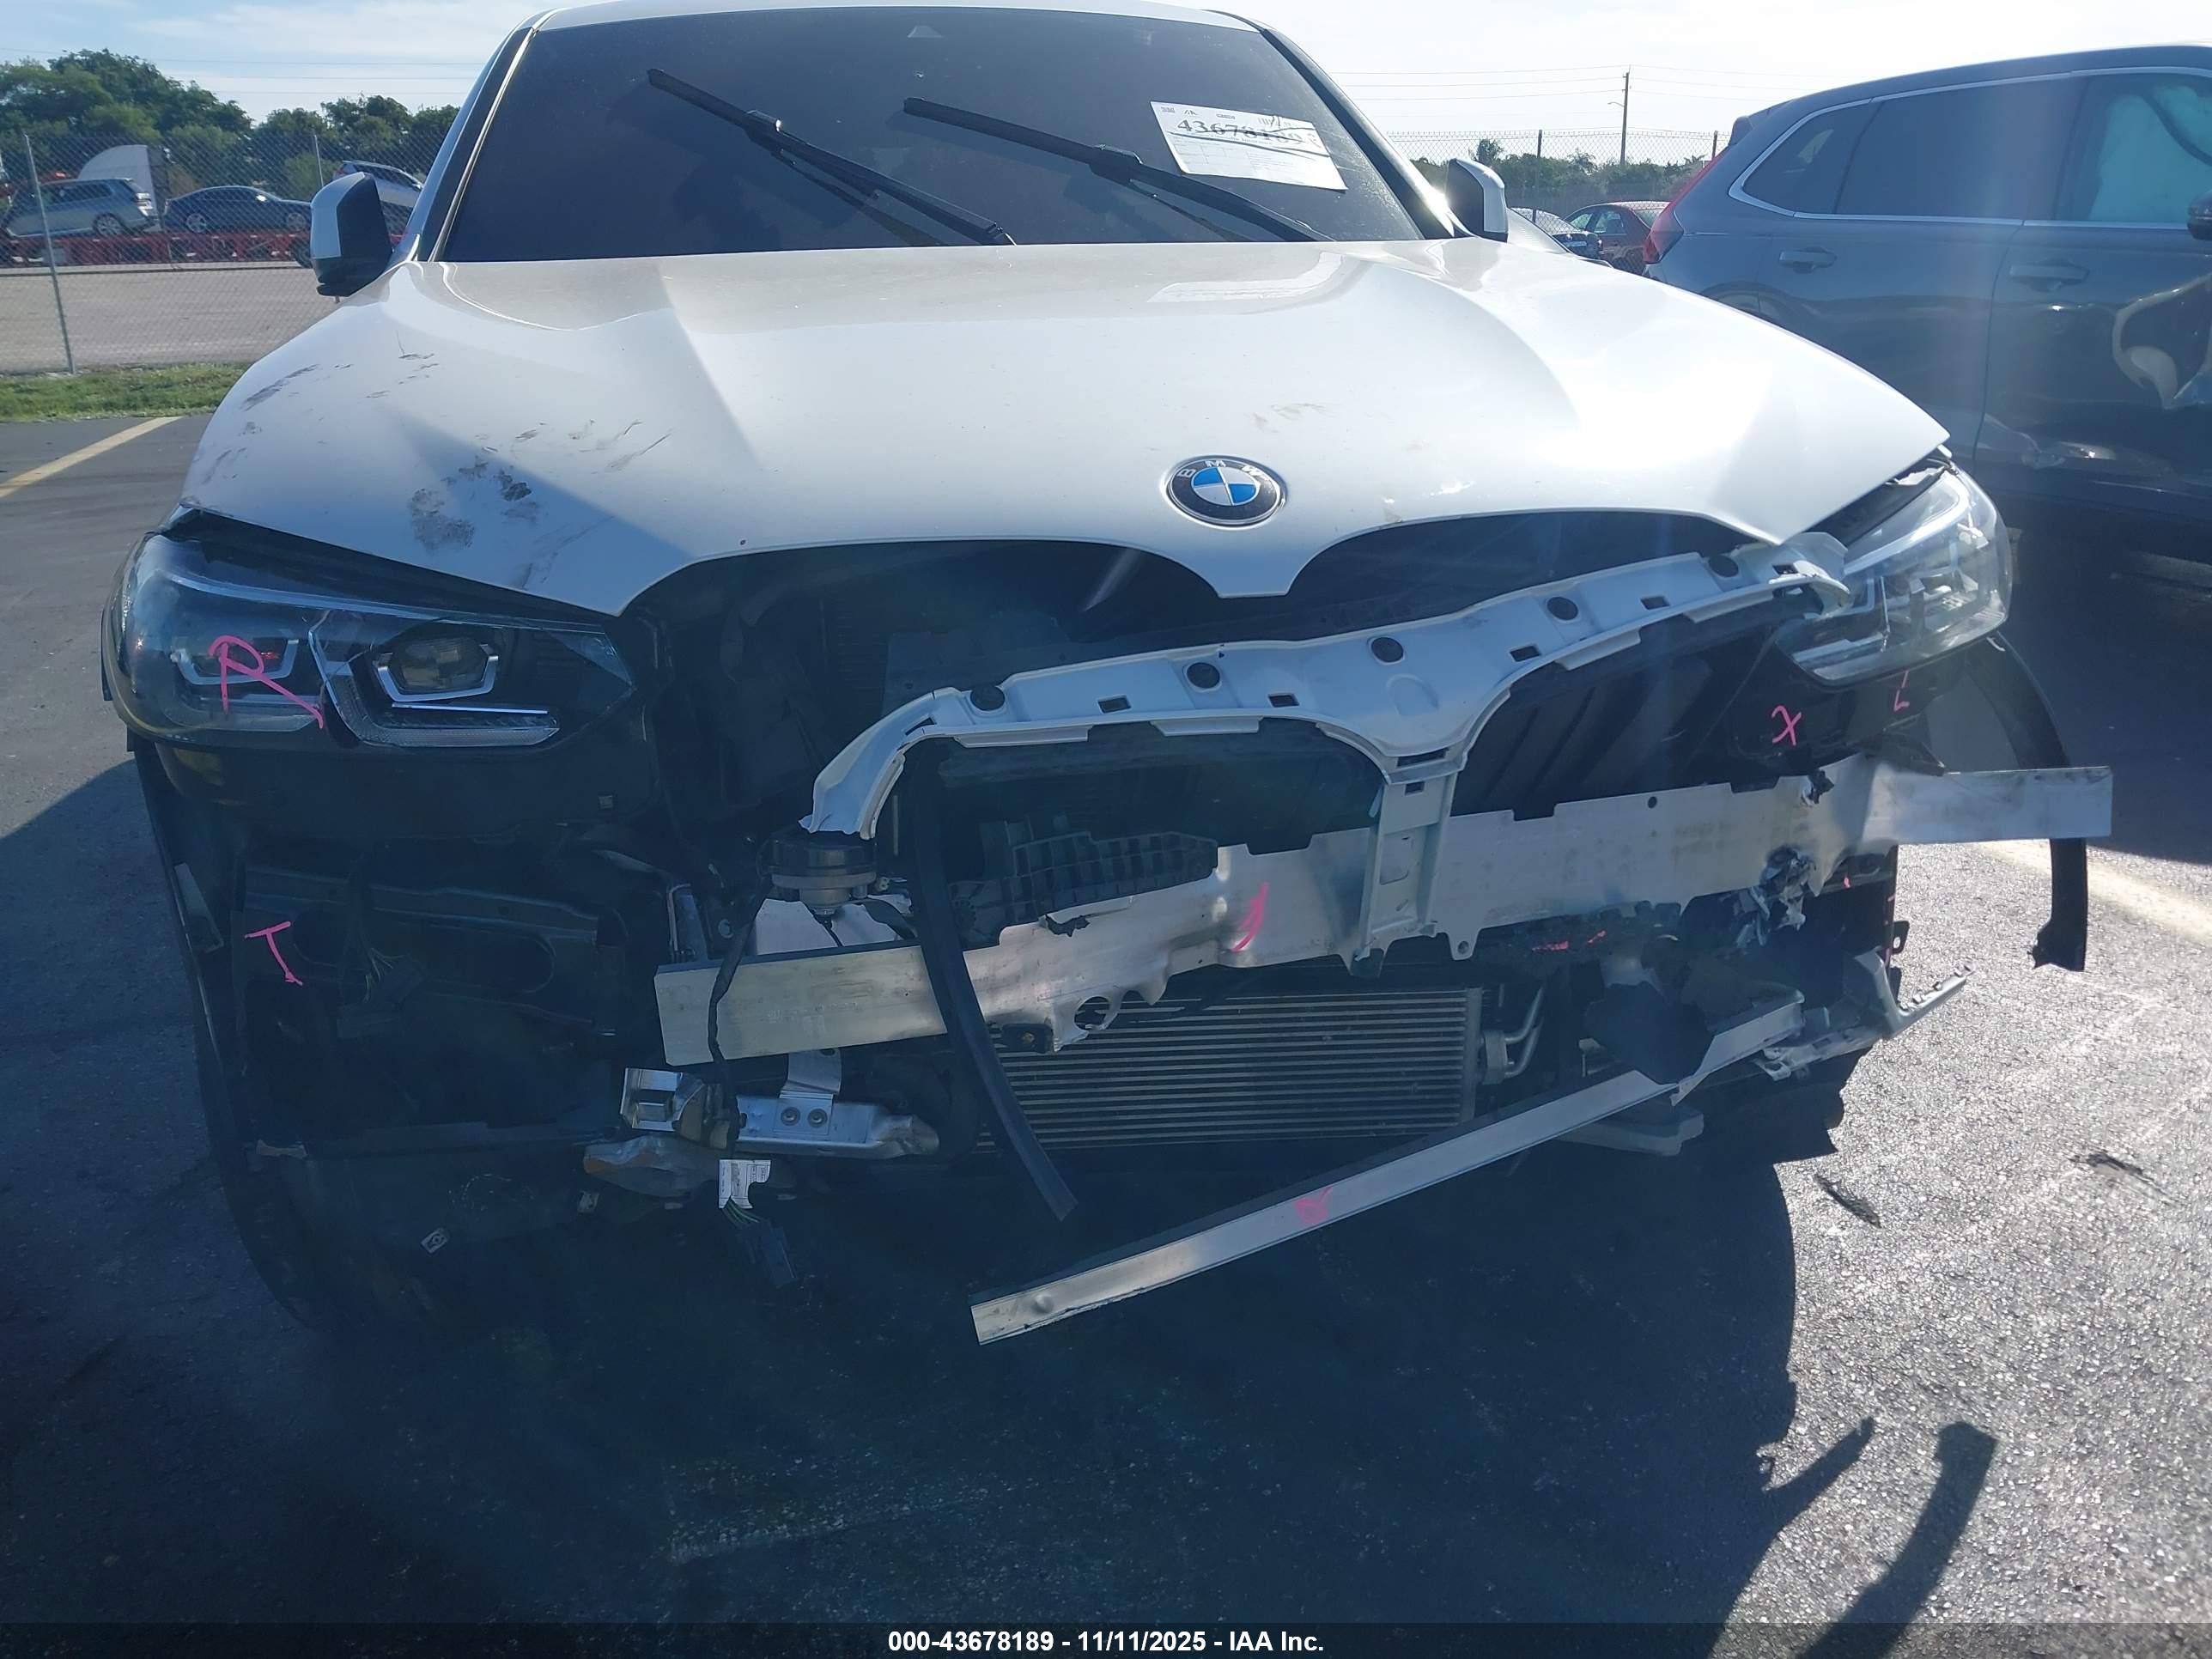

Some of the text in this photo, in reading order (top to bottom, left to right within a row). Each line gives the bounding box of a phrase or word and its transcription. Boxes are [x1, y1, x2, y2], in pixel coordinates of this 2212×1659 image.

[1176, 459, 1262, 478] BMW
[208, 635, 324, 729] R
[244, 921, 303, 987] T
